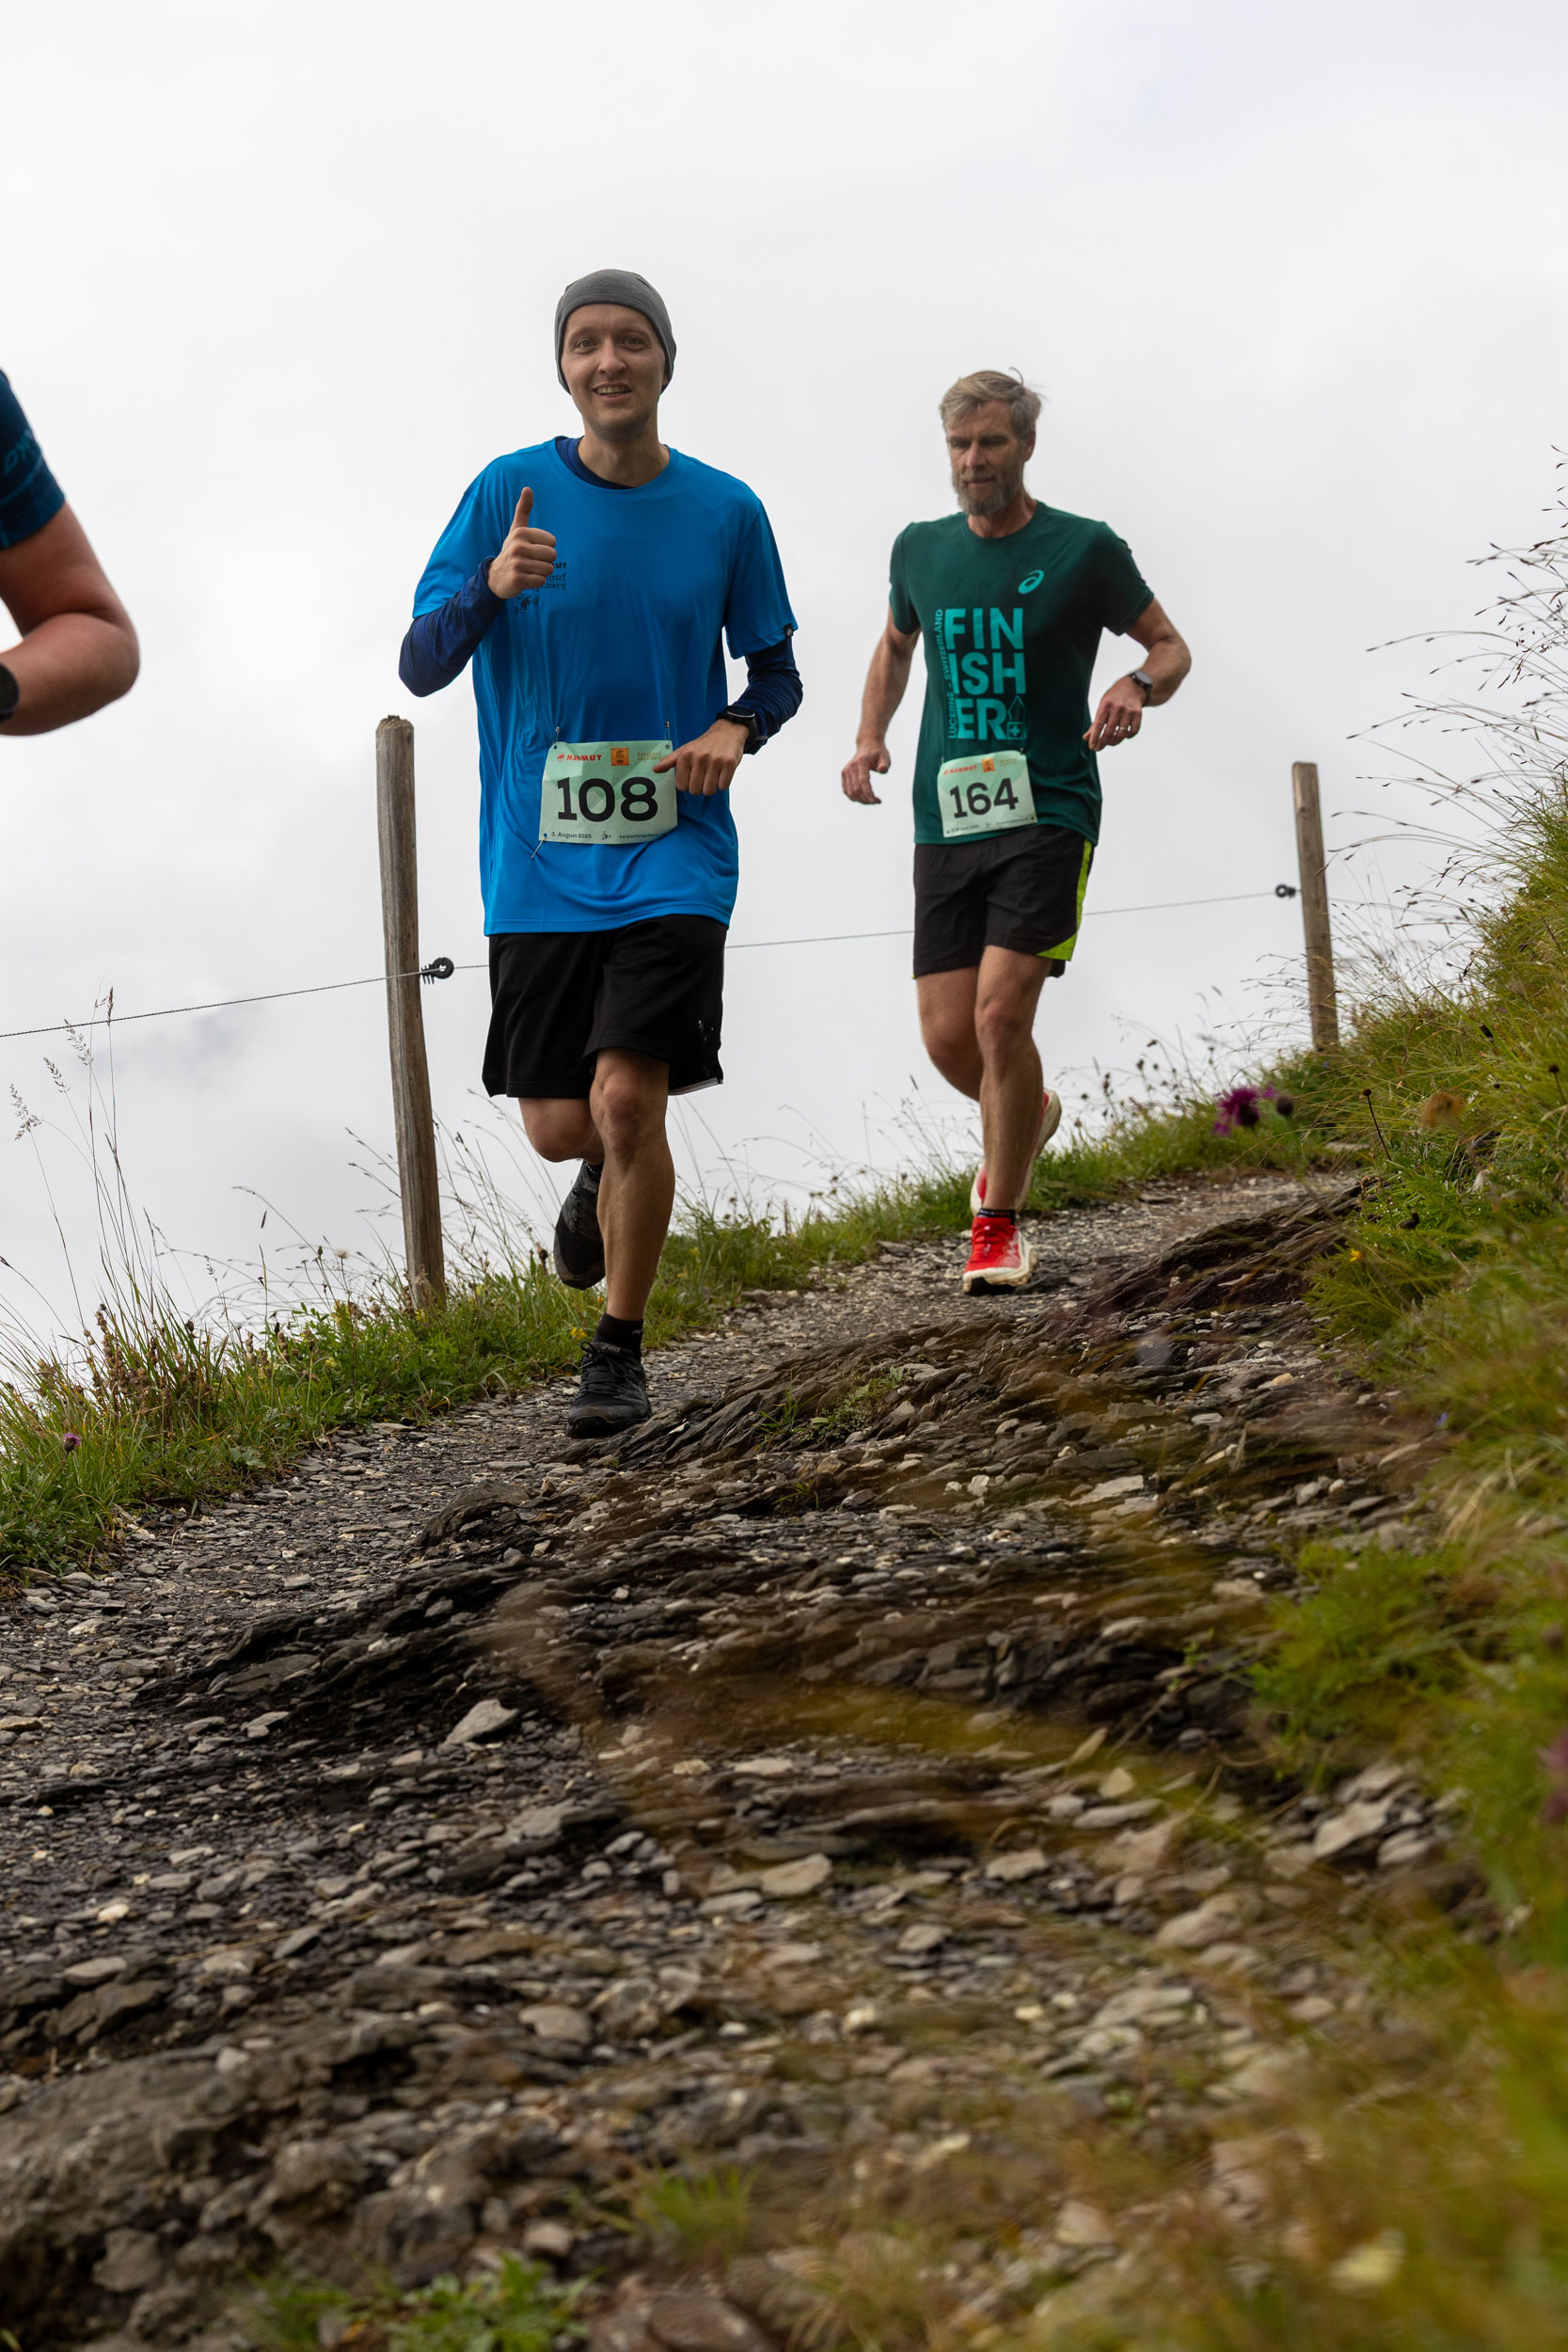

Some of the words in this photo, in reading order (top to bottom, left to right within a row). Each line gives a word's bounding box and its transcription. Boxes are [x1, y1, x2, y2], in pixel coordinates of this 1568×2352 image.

[934, 609, 952, 680] SWITZERLAND
[944, 608, 1023, 649] FIN
[948, 652, 1026, 694] ISH
[946, 691, 957, 739] LUCERNE
[956, 698, 1007, 739] ER
[557, 777, 658, 822] 108
[949, 778, 1019, 818] 164
